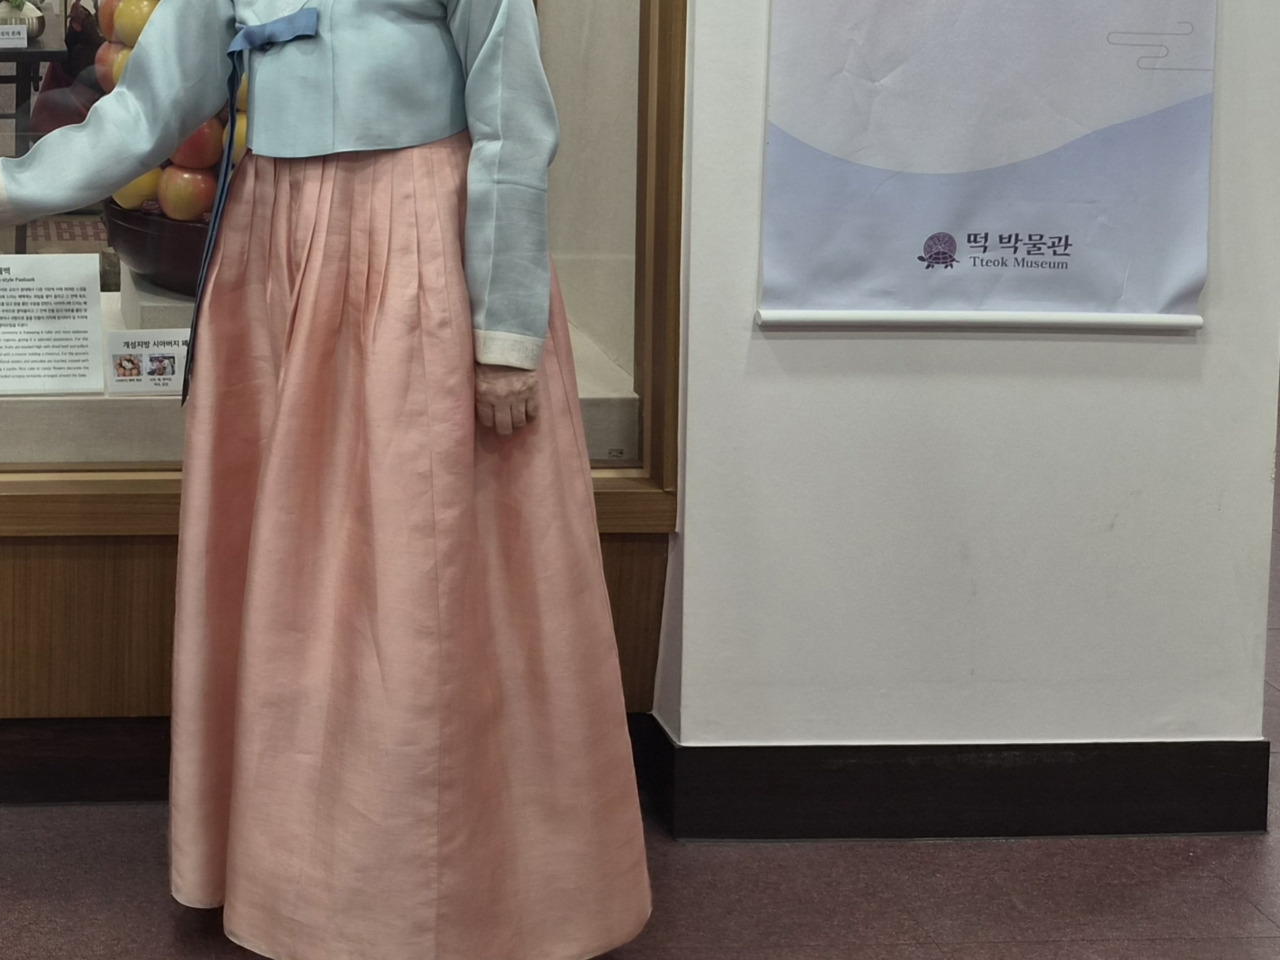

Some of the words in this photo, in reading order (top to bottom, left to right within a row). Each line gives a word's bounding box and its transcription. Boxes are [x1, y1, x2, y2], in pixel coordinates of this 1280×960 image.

[967, 233, 988, 253] 떡
[999, 233, 1072, 256] 박물관
[970, 257, 1008, 267] Tteok
[1013, 257, 1069, 270] Museum
[123, 340, 151, 350] 개성지방
[152, 340, 180, 348] 시아버지
